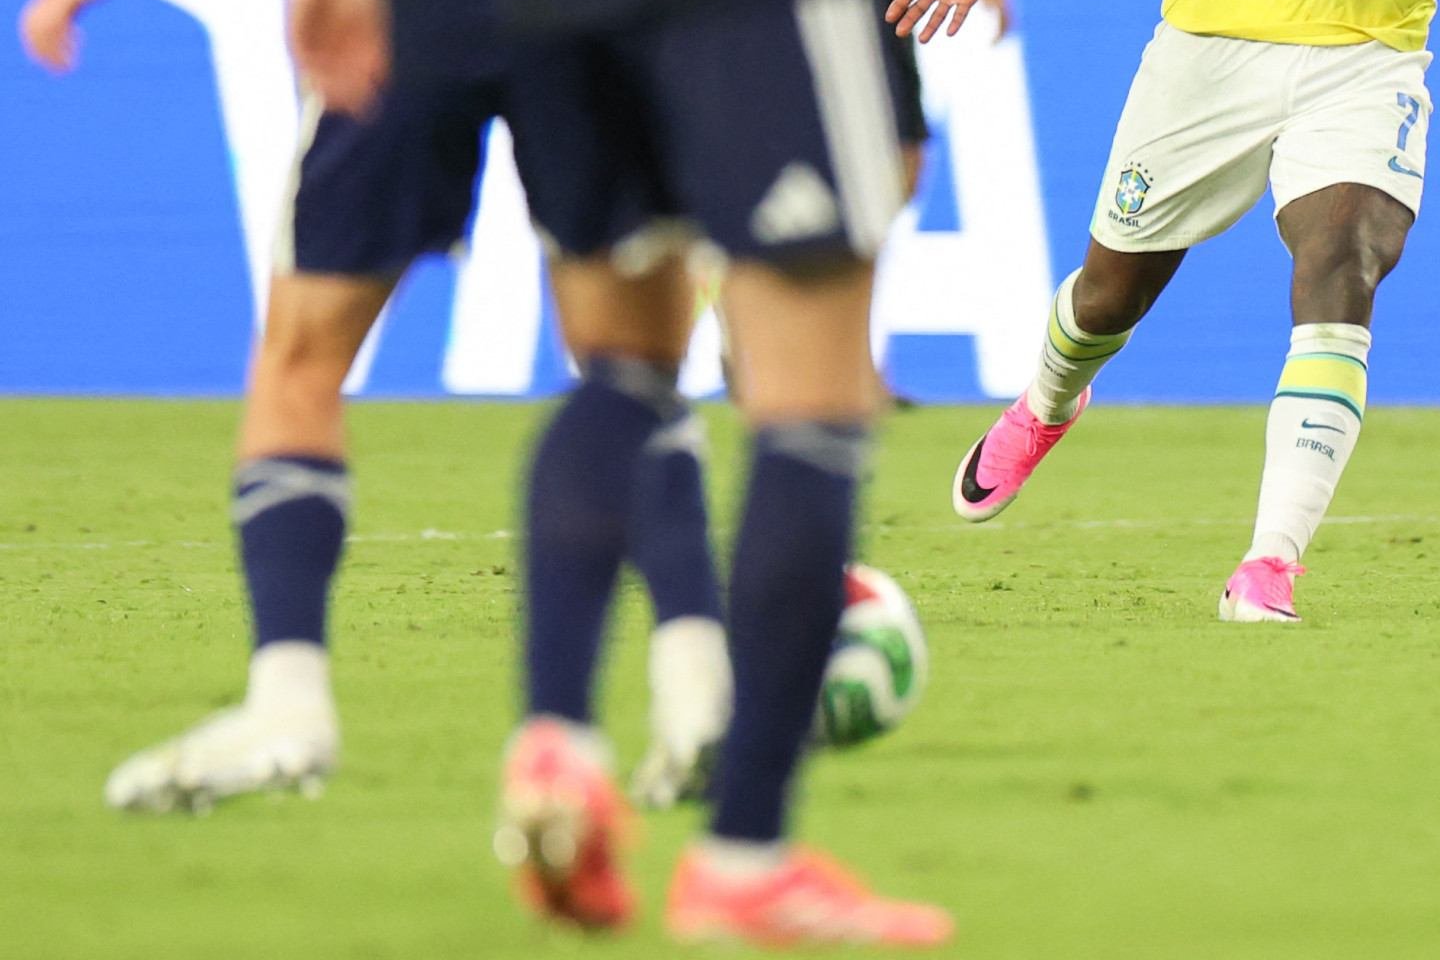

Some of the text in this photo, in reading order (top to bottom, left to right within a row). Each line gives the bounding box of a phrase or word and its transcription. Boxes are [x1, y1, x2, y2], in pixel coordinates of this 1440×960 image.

[1396, 91, 1420, 152] 7
[1108, 209, 1141, 228] BRASIL
[1296, 437, 1336, 462] BRASIL
